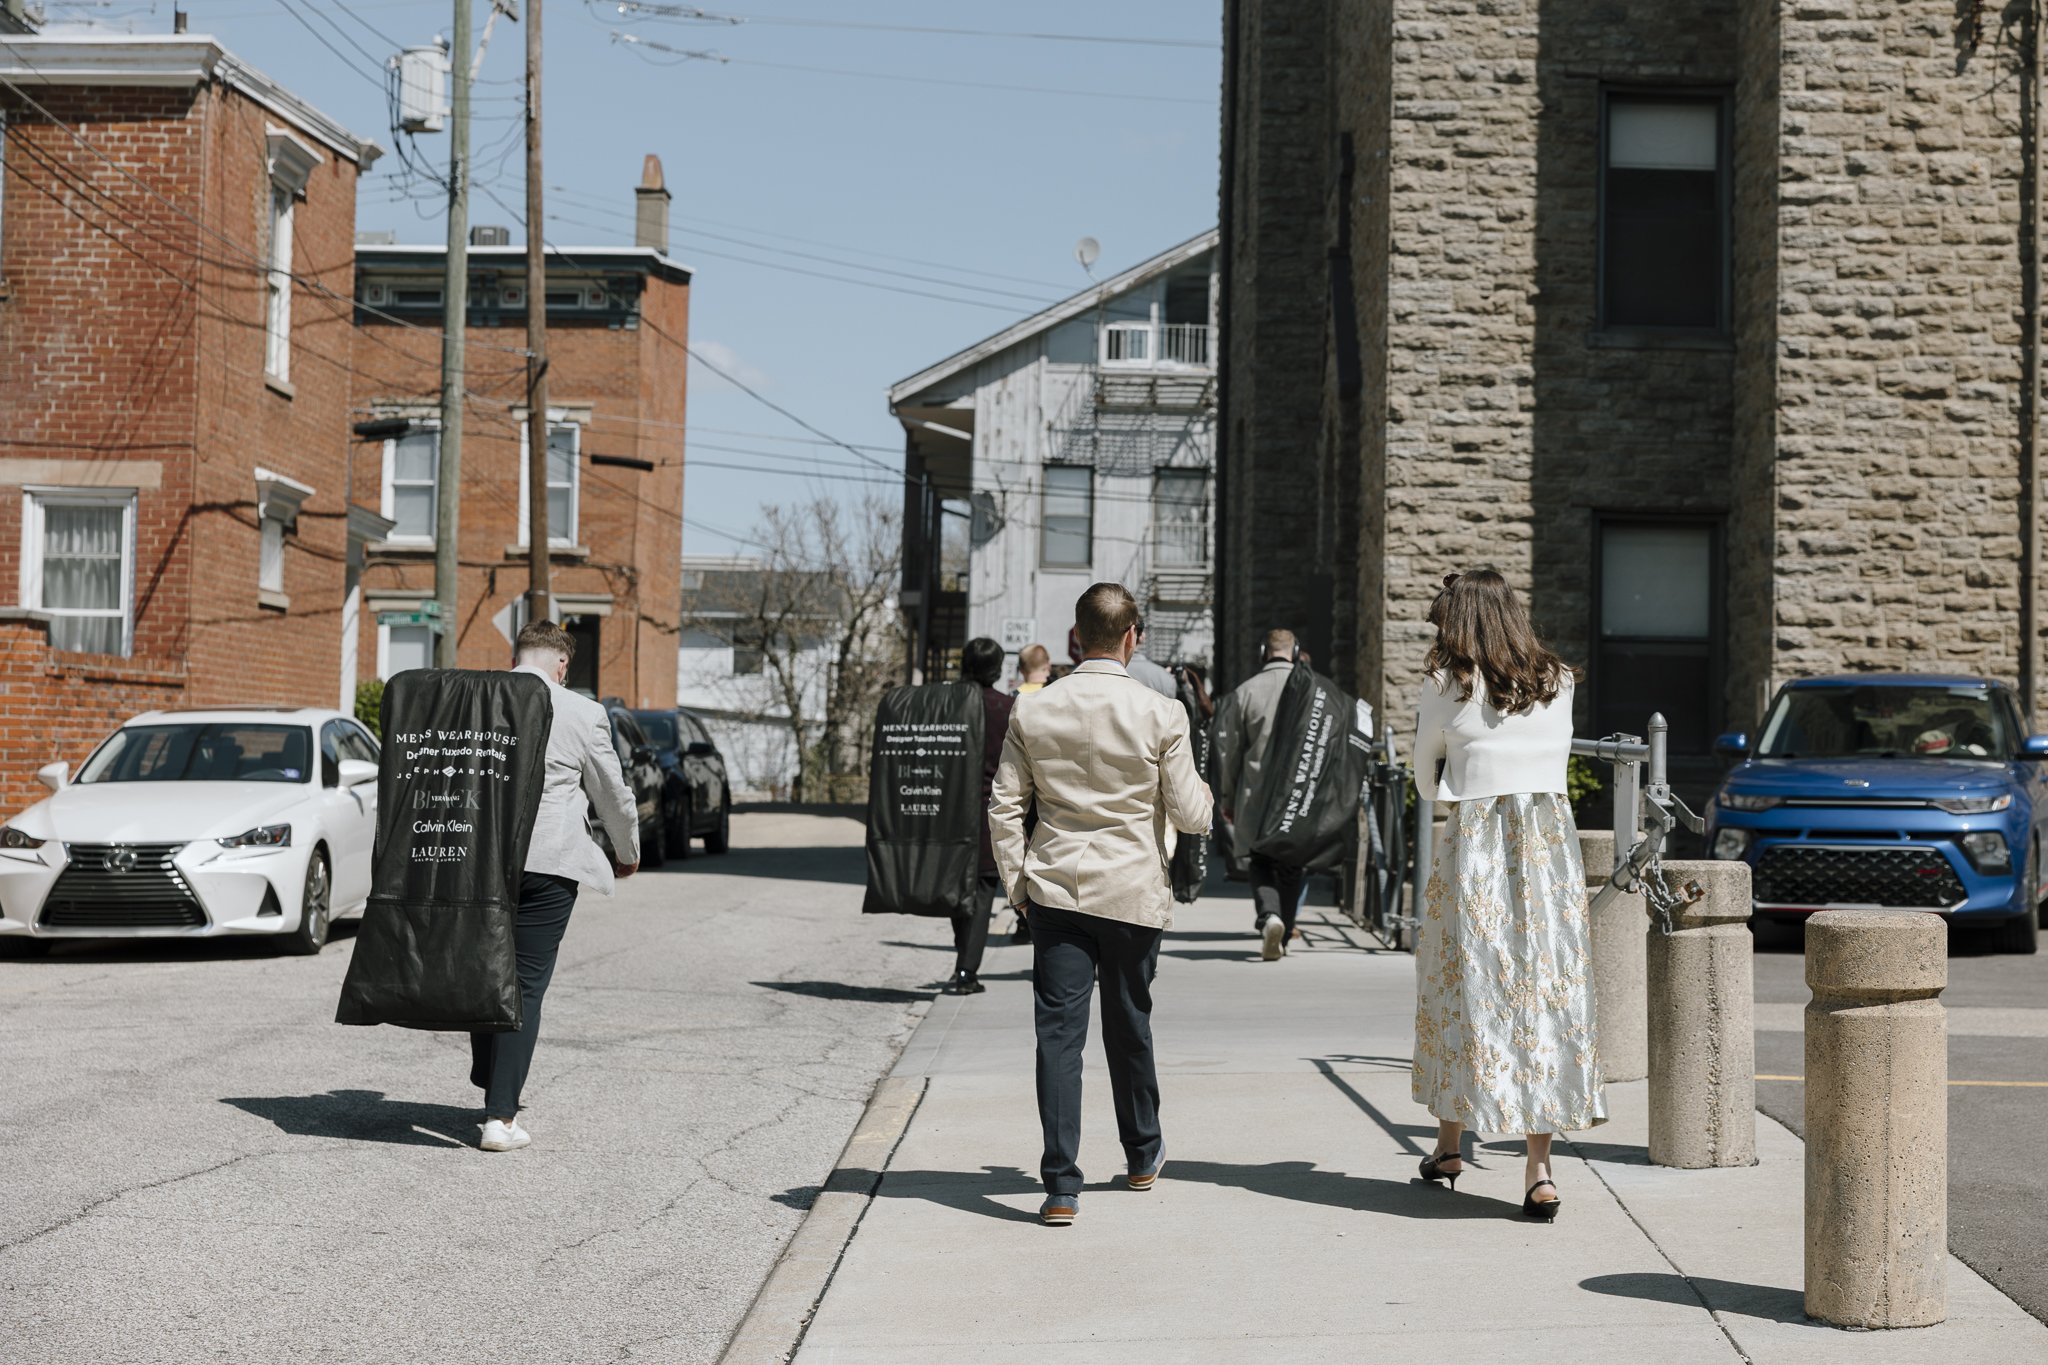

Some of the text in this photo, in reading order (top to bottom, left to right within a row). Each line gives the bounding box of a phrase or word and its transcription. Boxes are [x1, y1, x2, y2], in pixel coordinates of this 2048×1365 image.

[1006, 622, 1030, 631] ONE
[882, 723, 968, 732] MEN'S WEARHOUSE
[437, 730, 517, 745] WEARHOUSE
[441, 746, 472, 756] Tuxedo
[475, 748, 506, 761] Rentals
[1279, 687, 1326, 833] MEN'S WEARHOUSE
[412, 820, 473, 833] Calvin Klein
[411, 846, 468, 858] LAUREN
